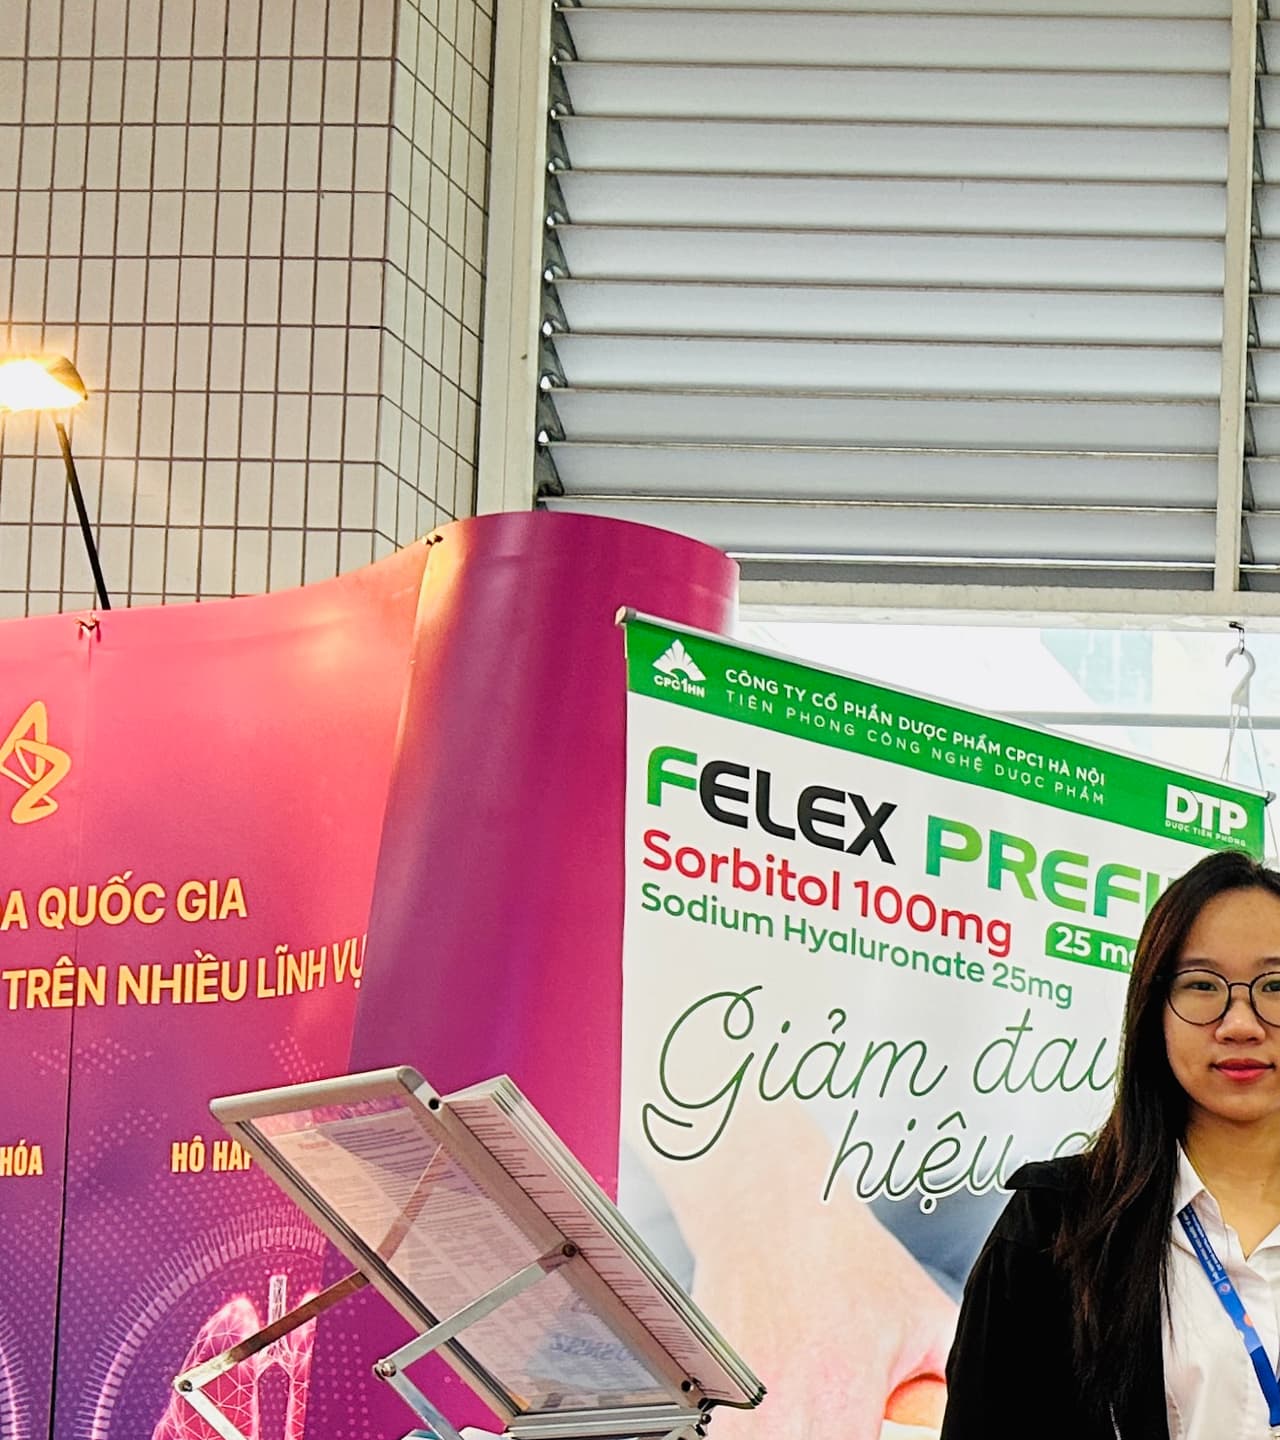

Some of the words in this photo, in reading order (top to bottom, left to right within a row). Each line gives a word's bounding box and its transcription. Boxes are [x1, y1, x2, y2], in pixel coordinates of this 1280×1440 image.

[653, 674, 706, 698] CPC1HN
[725, 668, 779, 695] CÔNG
[783, 684, 806, 703] TY
[812, 691, 838, 712] CỔ
[843, 701, 893, 727] PHẦN
[898, 716, 948, 743] DƯỢC
[952, 731, 1001, 757] PHẨM
[1005, 745, 1044, 770] CPC1
[1048, 757, 1070, 777] HÀ
[1075, 766, 1106, 787] NỘI
[726, 689, 774, 715] TIÊN
[786, 707, 855, 736] PHONG
[866, 728, 922, 755] CÔNG
[931, 749, 984, 774] NGHỆ
[646, 745, 898, 866] FELEX
[926, 815, 1168, 918] PREFI
[1164, 783, 1249, 837] DTP
[37, 871, 166, 930] QUỐC
[176, 876, 247, 923] GIA
[642, 829, 841, 911] Sorbitol
[853, 880, 1012, 959] 100mg
[2, 954, 105, 1011] TRÊN
[117, 949, 247, 1006] NHIỀU
[258, 942, 327, 999] LĨNH
[642, 881, 774, 938] Sodium
[783, 917, 986, 985] Hyaluronate
[992, 962, 1073, 1010] 25mg
[1055, 926, 1092, 958] 25
[642, 985, 948, 1161] Giảm
[171, 1135, 205, 1174] HÔ
[823, 1109, 1013, 1210] hiệu
